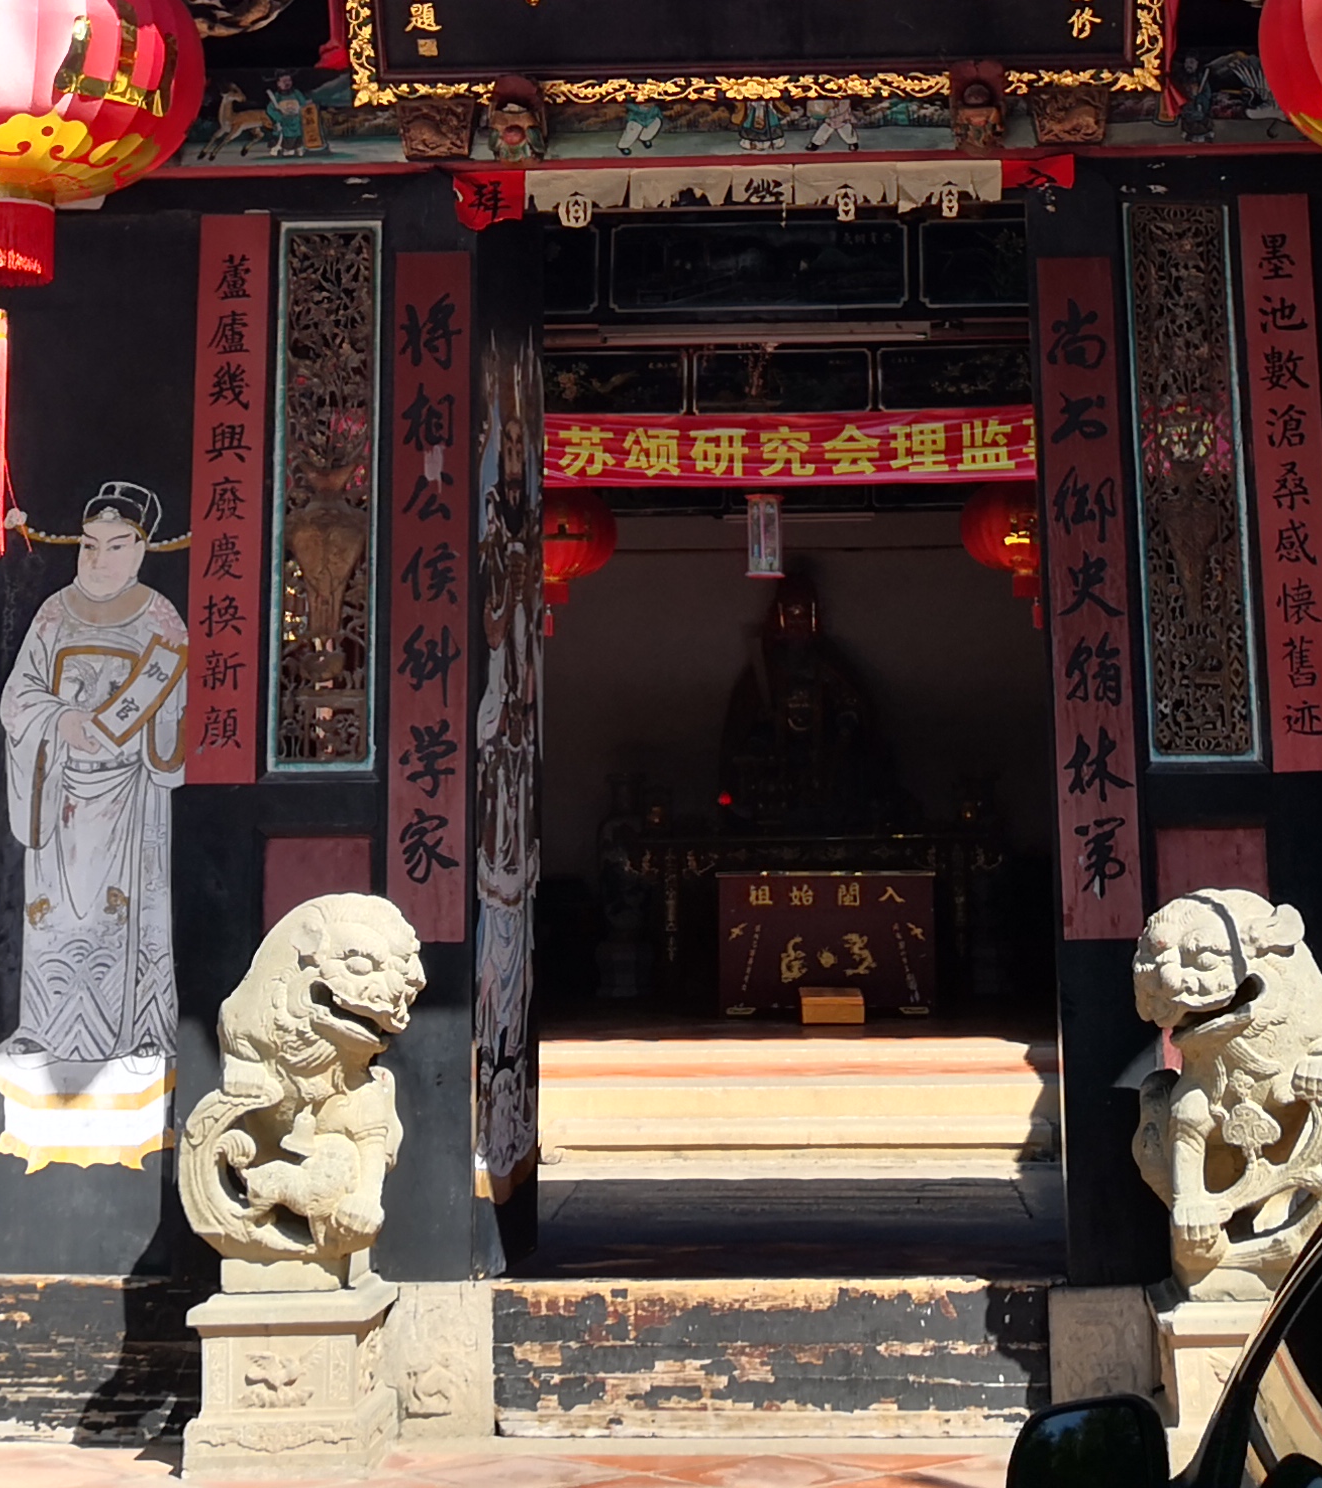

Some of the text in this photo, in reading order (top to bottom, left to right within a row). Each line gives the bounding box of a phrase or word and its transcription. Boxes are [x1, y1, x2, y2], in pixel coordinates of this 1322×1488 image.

[558, 417, 1035, 478] 苏颂研究会理监
[116, 661, 169, 721] 加官
